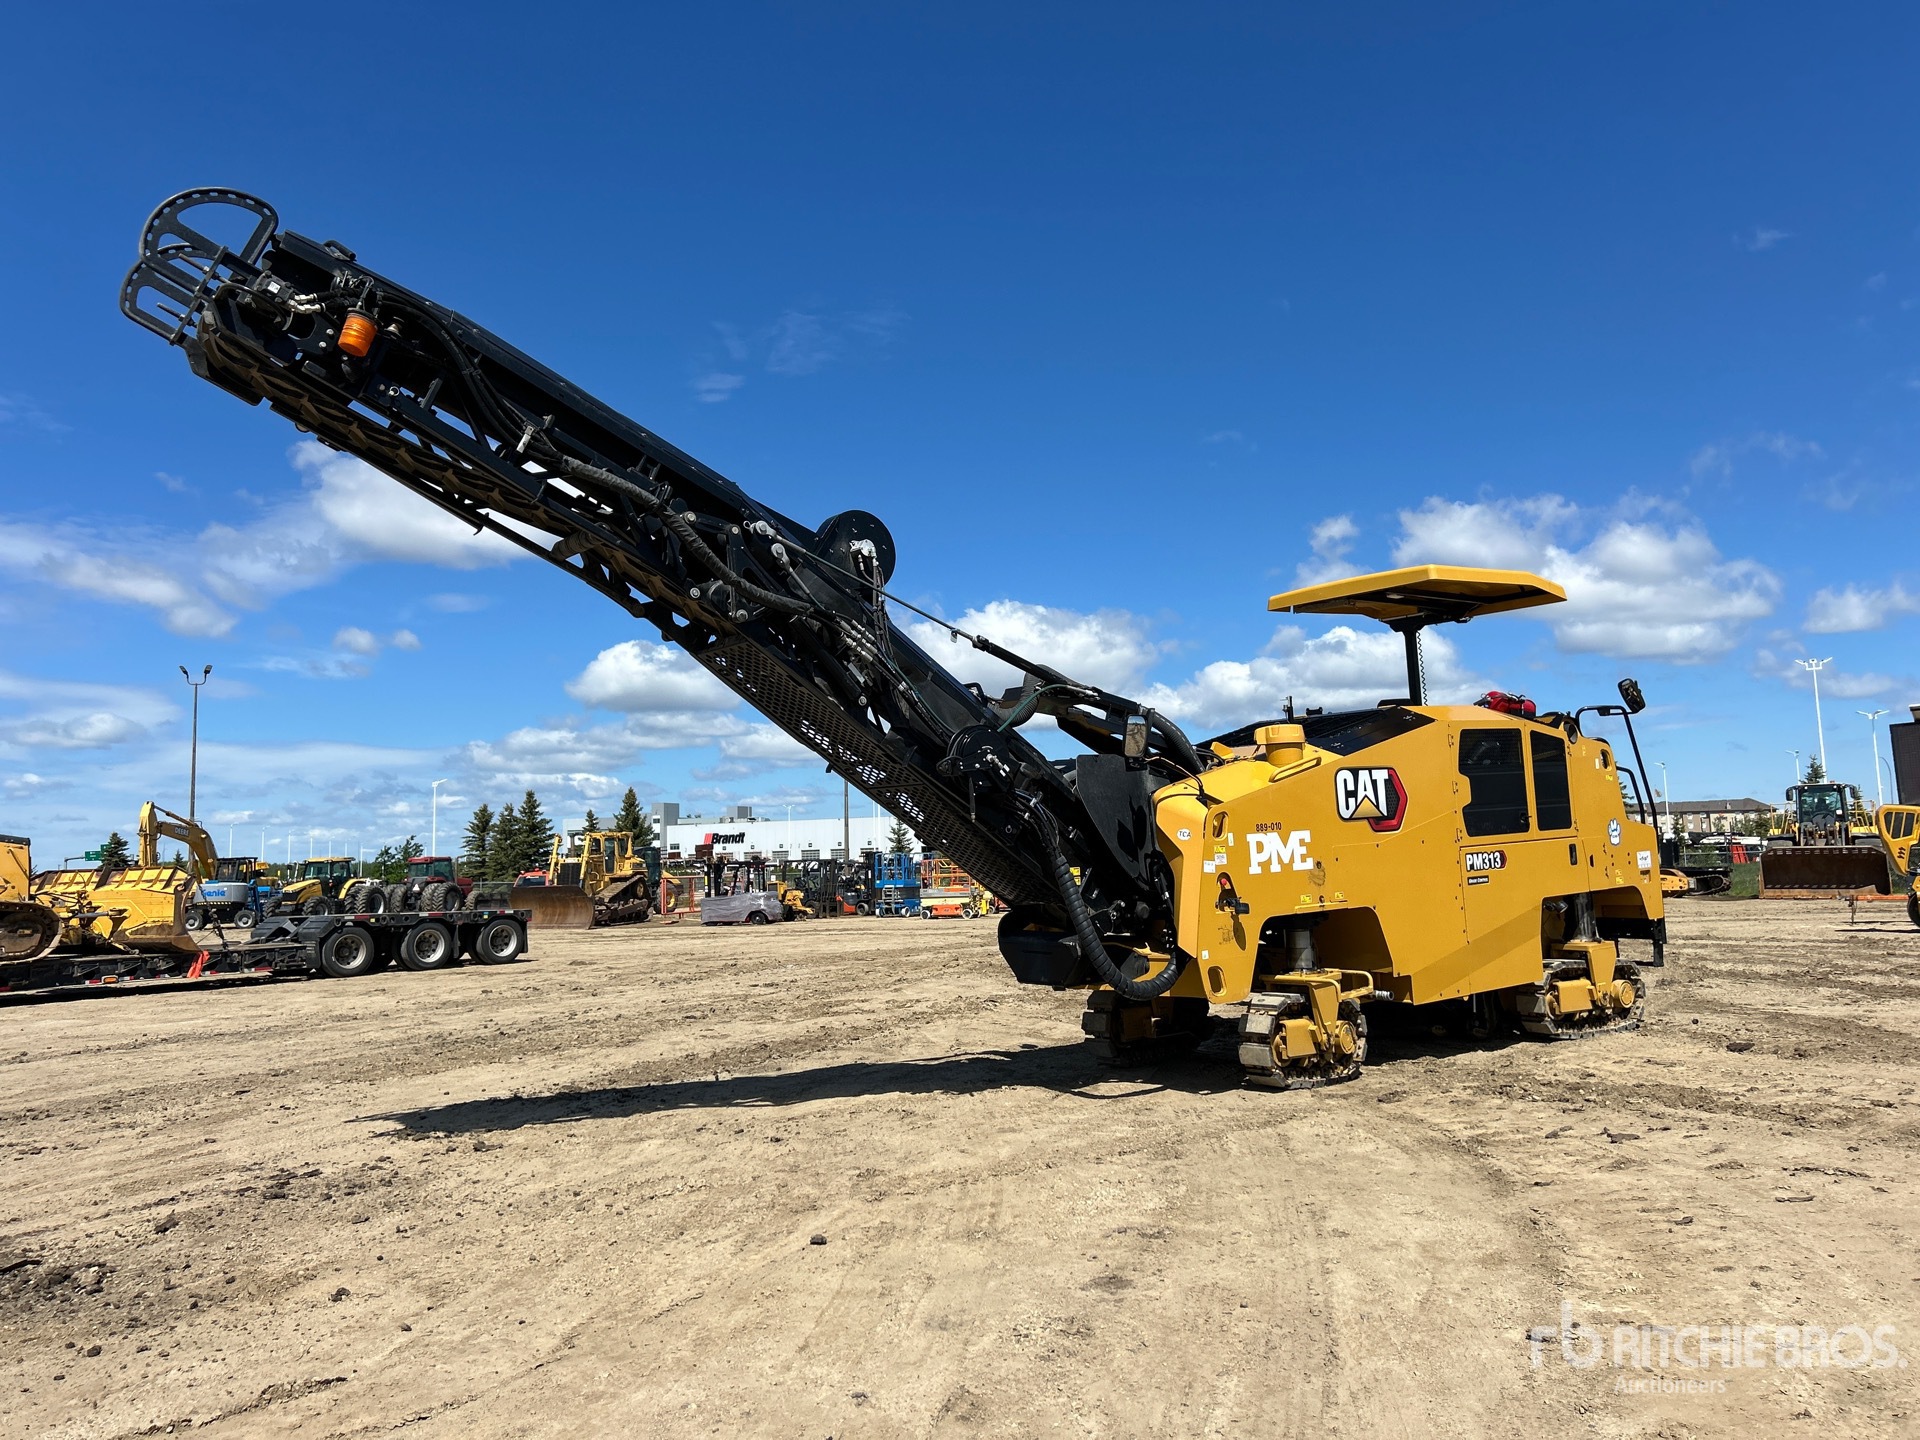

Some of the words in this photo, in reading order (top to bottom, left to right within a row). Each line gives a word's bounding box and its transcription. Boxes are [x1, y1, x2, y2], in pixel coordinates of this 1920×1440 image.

[1336, 769, 1389, 819] CAT
[1255, 822, 1282, 832] 889-010
[711, 832, 745, 844] Brandt
[1246, 830, 1314, 875] PME
[1465, 851, 1501, 871] PM313
